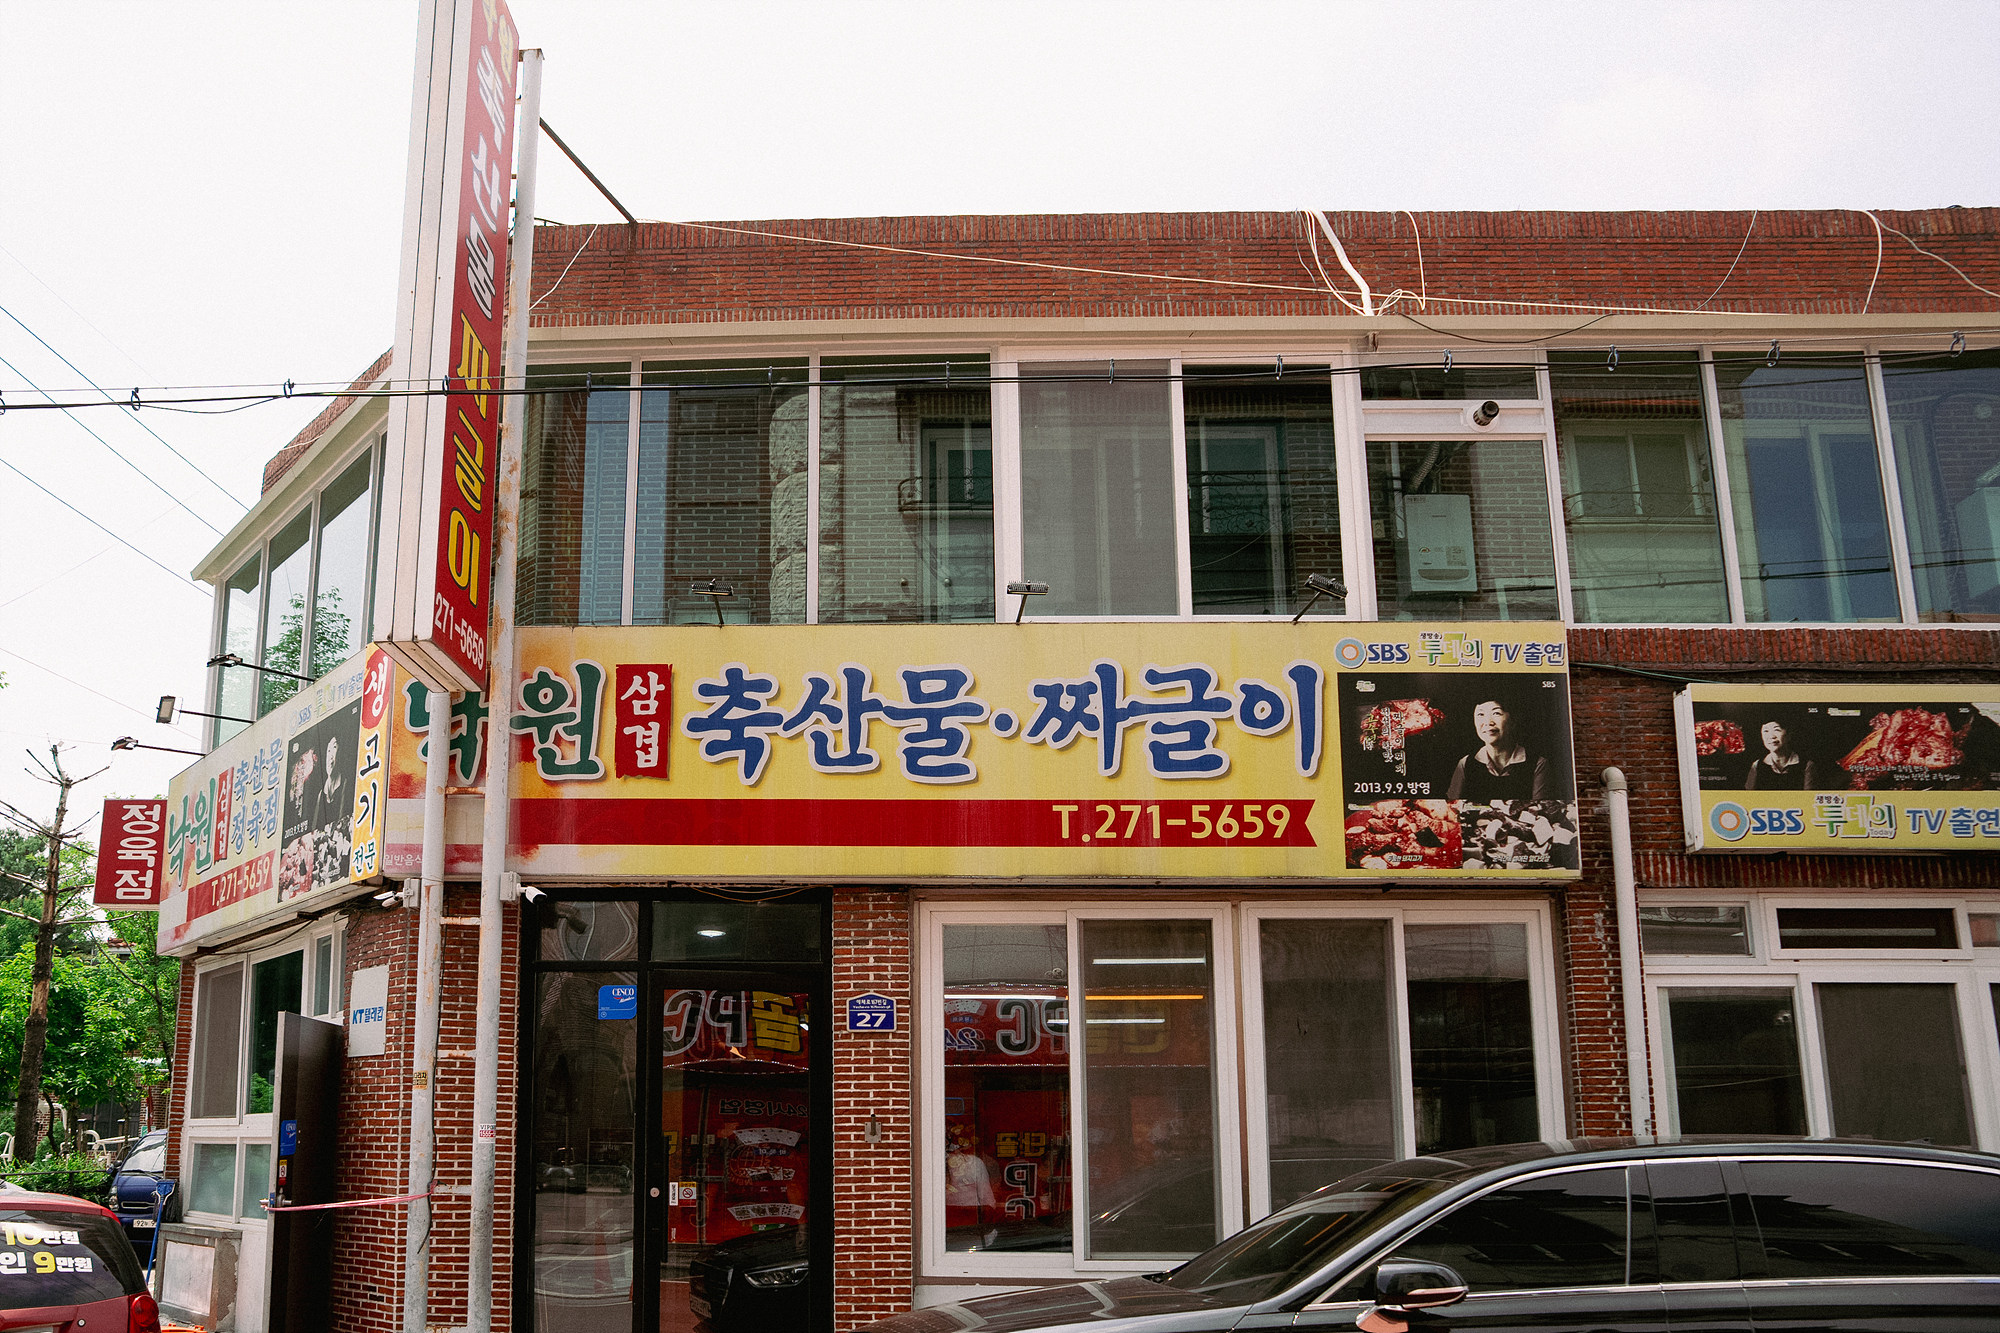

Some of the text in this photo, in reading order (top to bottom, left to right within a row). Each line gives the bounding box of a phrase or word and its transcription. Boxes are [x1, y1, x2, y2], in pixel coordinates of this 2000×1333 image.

[465, 44, 505, 320] 축산물
[448, 308, 491, 608] 짜글이
[434, 592, 485, 671] 271-5659
[1367, 643, 1410, 663] SBS
[1490, 643, 1521, 663] TV
[1524, 642, 1565, 666] 출연
[298, 704, 312, 728] SBS
[620, 671, 666, 768] 삼겹
[356, 655, 389, 837] 생고기
[234, 738, 283, 803] 축산물
[1354, 782, 1430, 795] 2013.9.9.방영
[168, 778, 231, 886] 낙원 삼겹
[231, 788, 279, 854] 정육점
[1052, 804, 1292, 843] T.271-5659
[1750, 808, 1804, 833] SBS
[1905, 808, 1946, 834] TV
[1949, 807, 2000, 838] 출연
[1869, 828, 1894, 837] Today
[113, 804, 161, 900] 정육점
[352, 844, 377, 879] 전문
[211, 856, 271, 907] T.271-5659
[612, 988, 635, 997] CESCO
[856, 1012, 887, 1027] 27
[33, 1251, 93, 1274] 9만원
